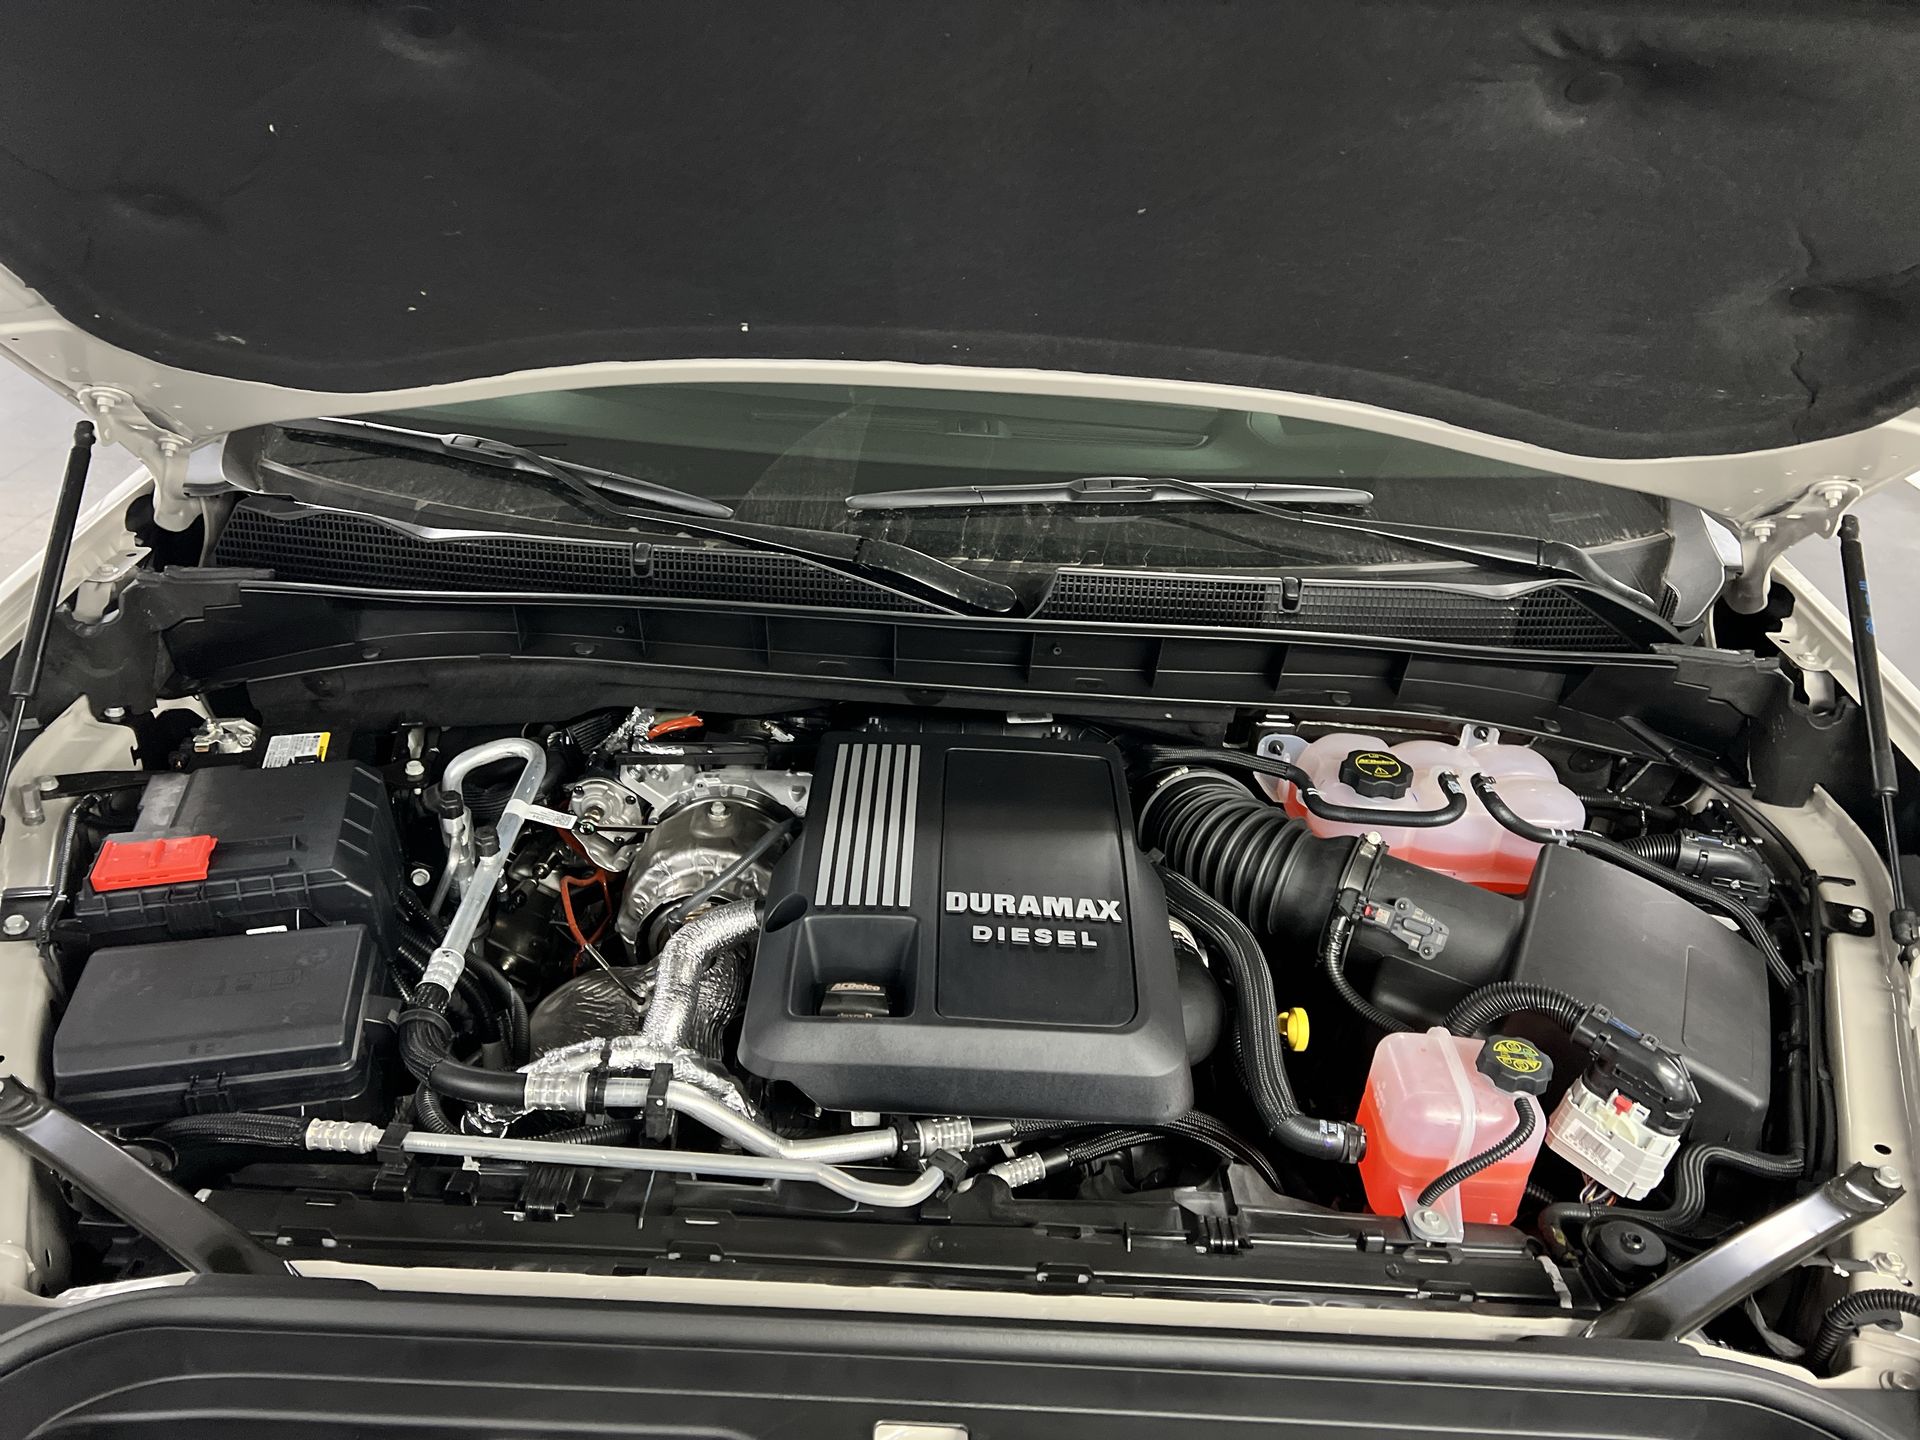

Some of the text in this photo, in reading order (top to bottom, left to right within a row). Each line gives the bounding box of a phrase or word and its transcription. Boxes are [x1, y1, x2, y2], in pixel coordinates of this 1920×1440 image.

[945, 891, 1123, 923] DURAMAX
[972, 925, 1098, 948] DIESEL
[831, 982, 881, 991] ACDelco
